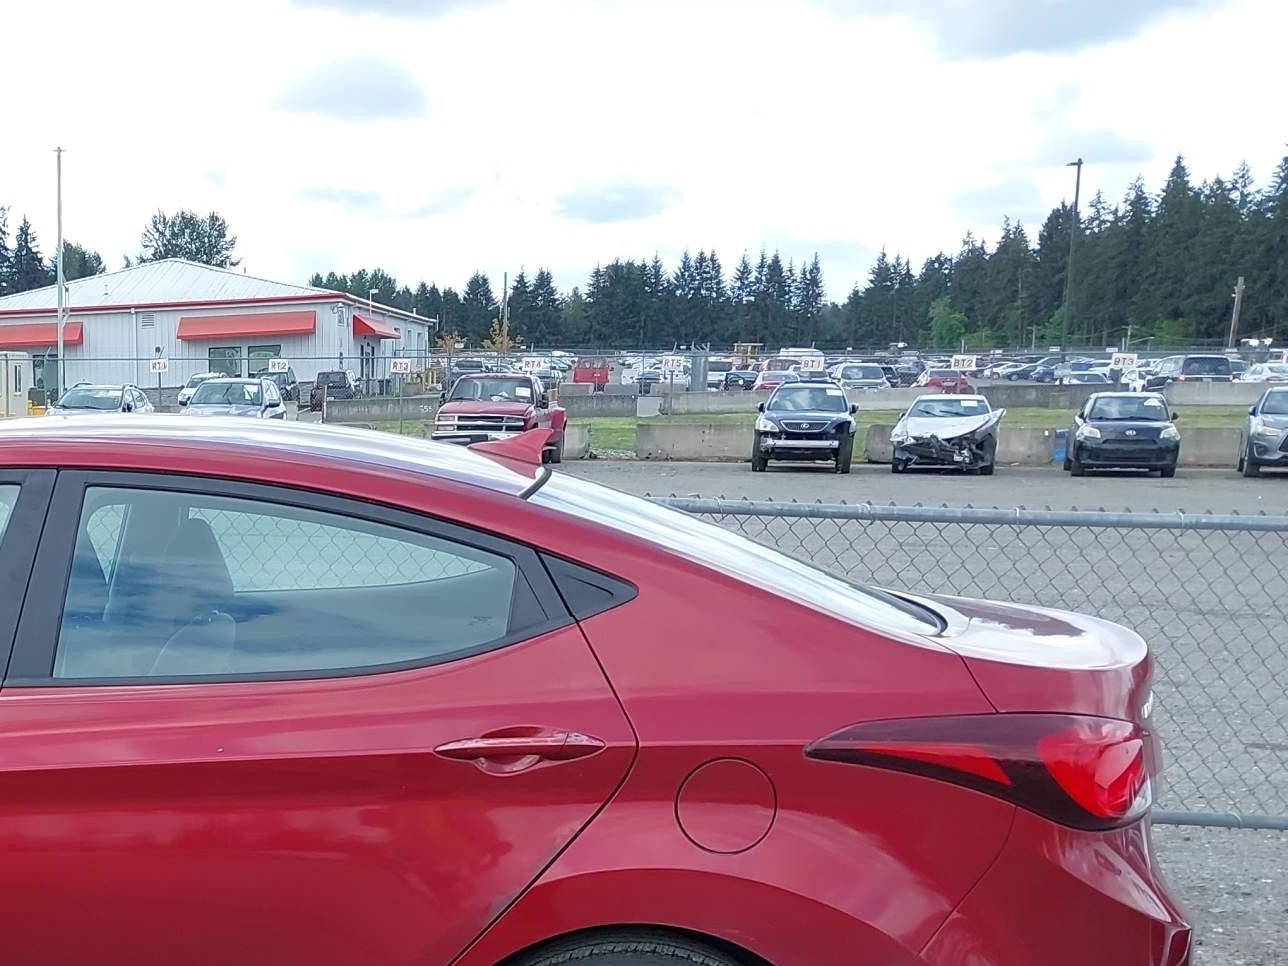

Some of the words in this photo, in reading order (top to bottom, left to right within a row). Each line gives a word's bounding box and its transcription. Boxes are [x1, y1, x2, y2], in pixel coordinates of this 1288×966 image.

[271, 362, 286, 370] RT2
[392, 361, 409, 370] RT3
[663, 359, 682, 367] RT5
[803, 359, 821, 368] BT1
[953, 358, 973, 368] BT2
[1113, 357, 1134, 366] BT3
